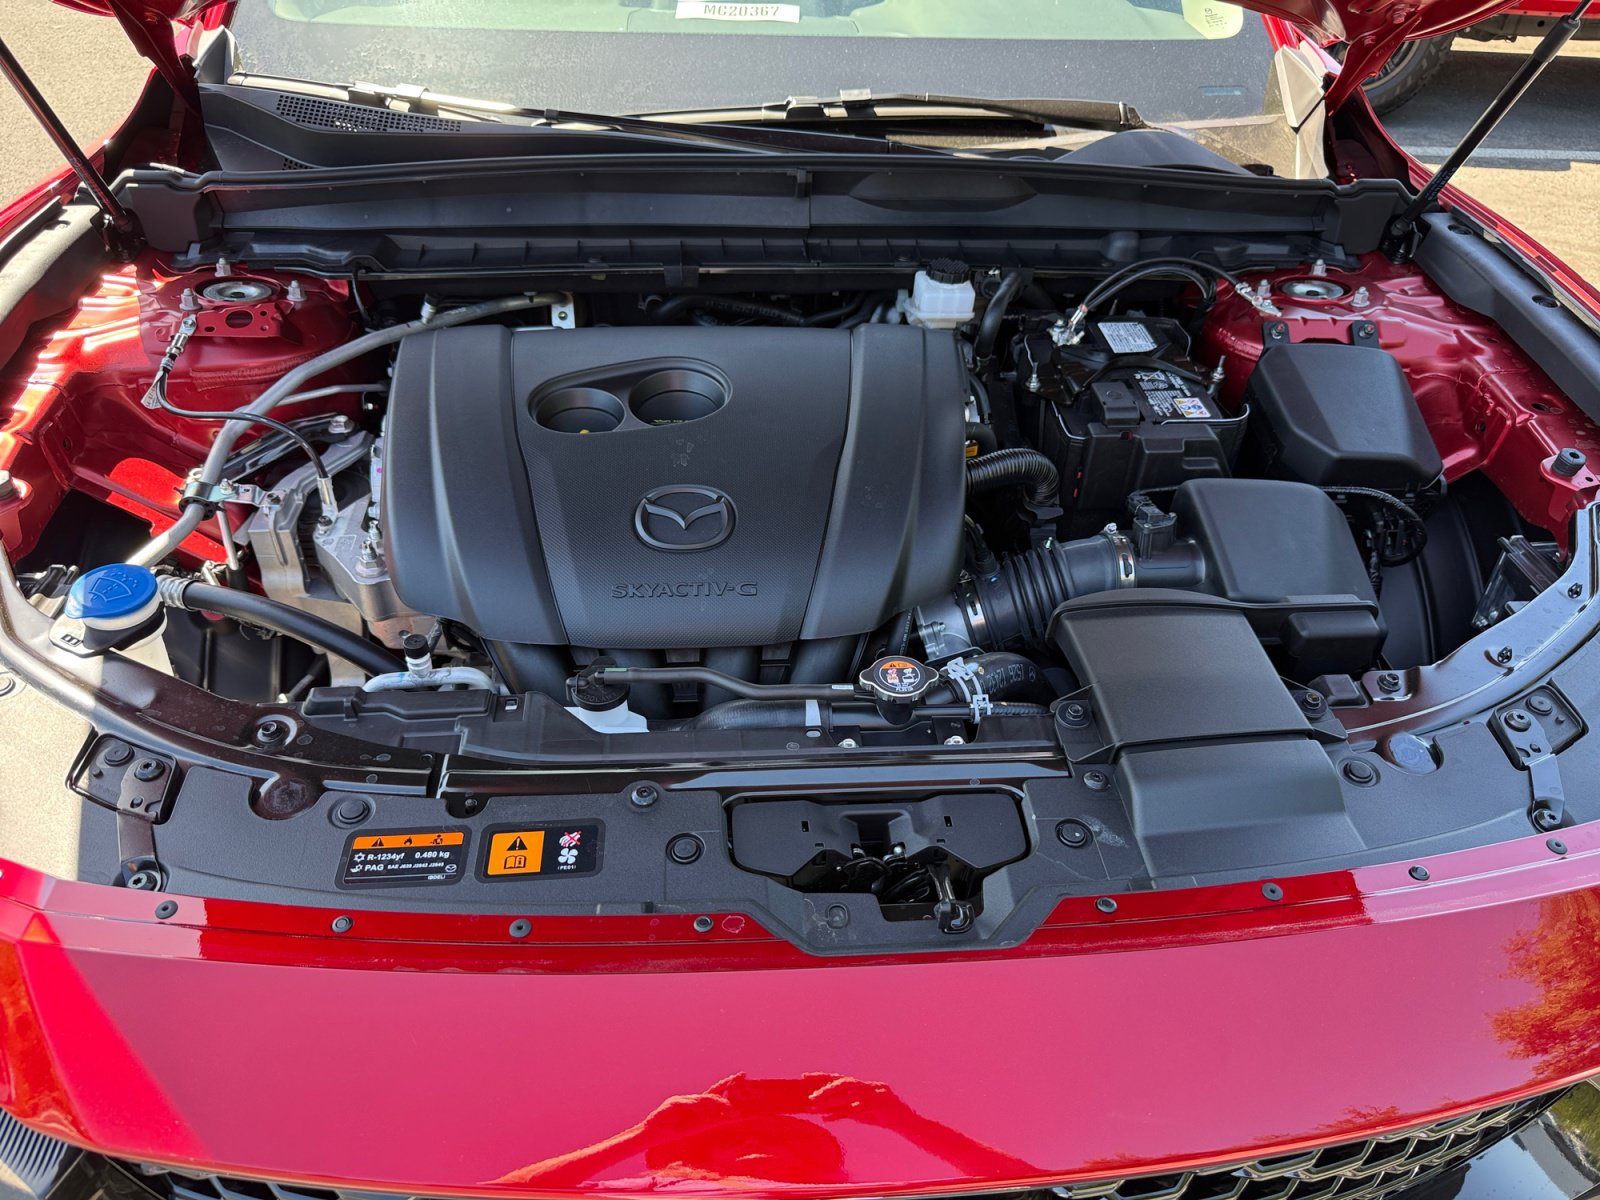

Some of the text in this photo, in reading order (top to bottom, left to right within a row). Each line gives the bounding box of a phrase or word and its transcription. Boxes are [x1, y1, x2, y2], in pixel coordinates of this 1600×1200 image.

[703, 4, 780, 17] MC20367
[611, 580, 758, 599] SKYACTIV-G
[366, 850, 450, 862] R-1234yf 0.480 kg
